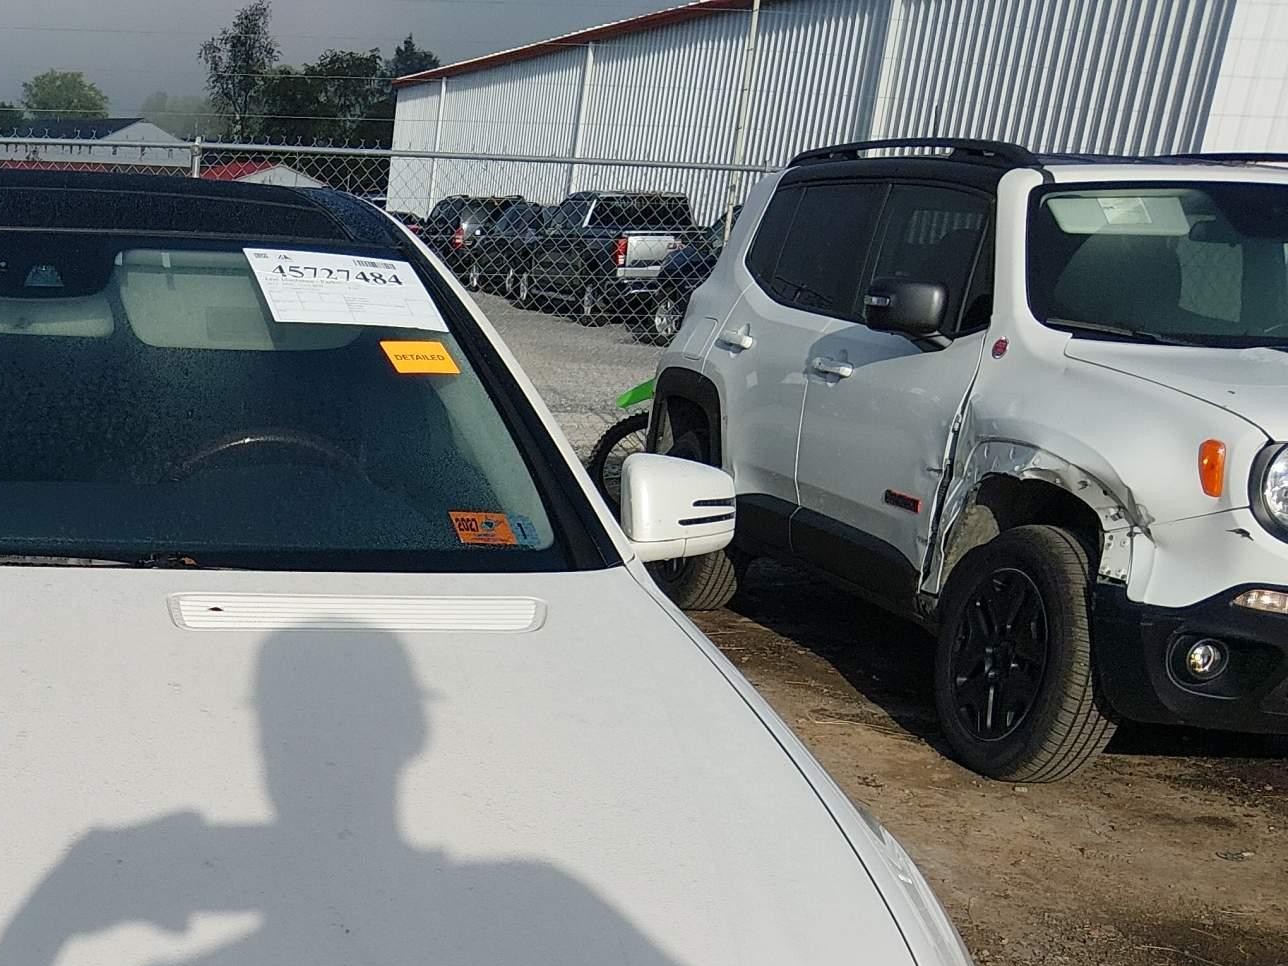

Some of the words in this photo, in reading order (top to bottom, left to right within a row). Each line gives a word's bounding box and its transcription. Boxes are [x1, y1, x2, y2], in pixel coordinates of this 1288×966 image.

[272, 264, 403, 286] 45727484
[455, 518, 479, 532] 2027
[516, 522, 527, 539] 1
